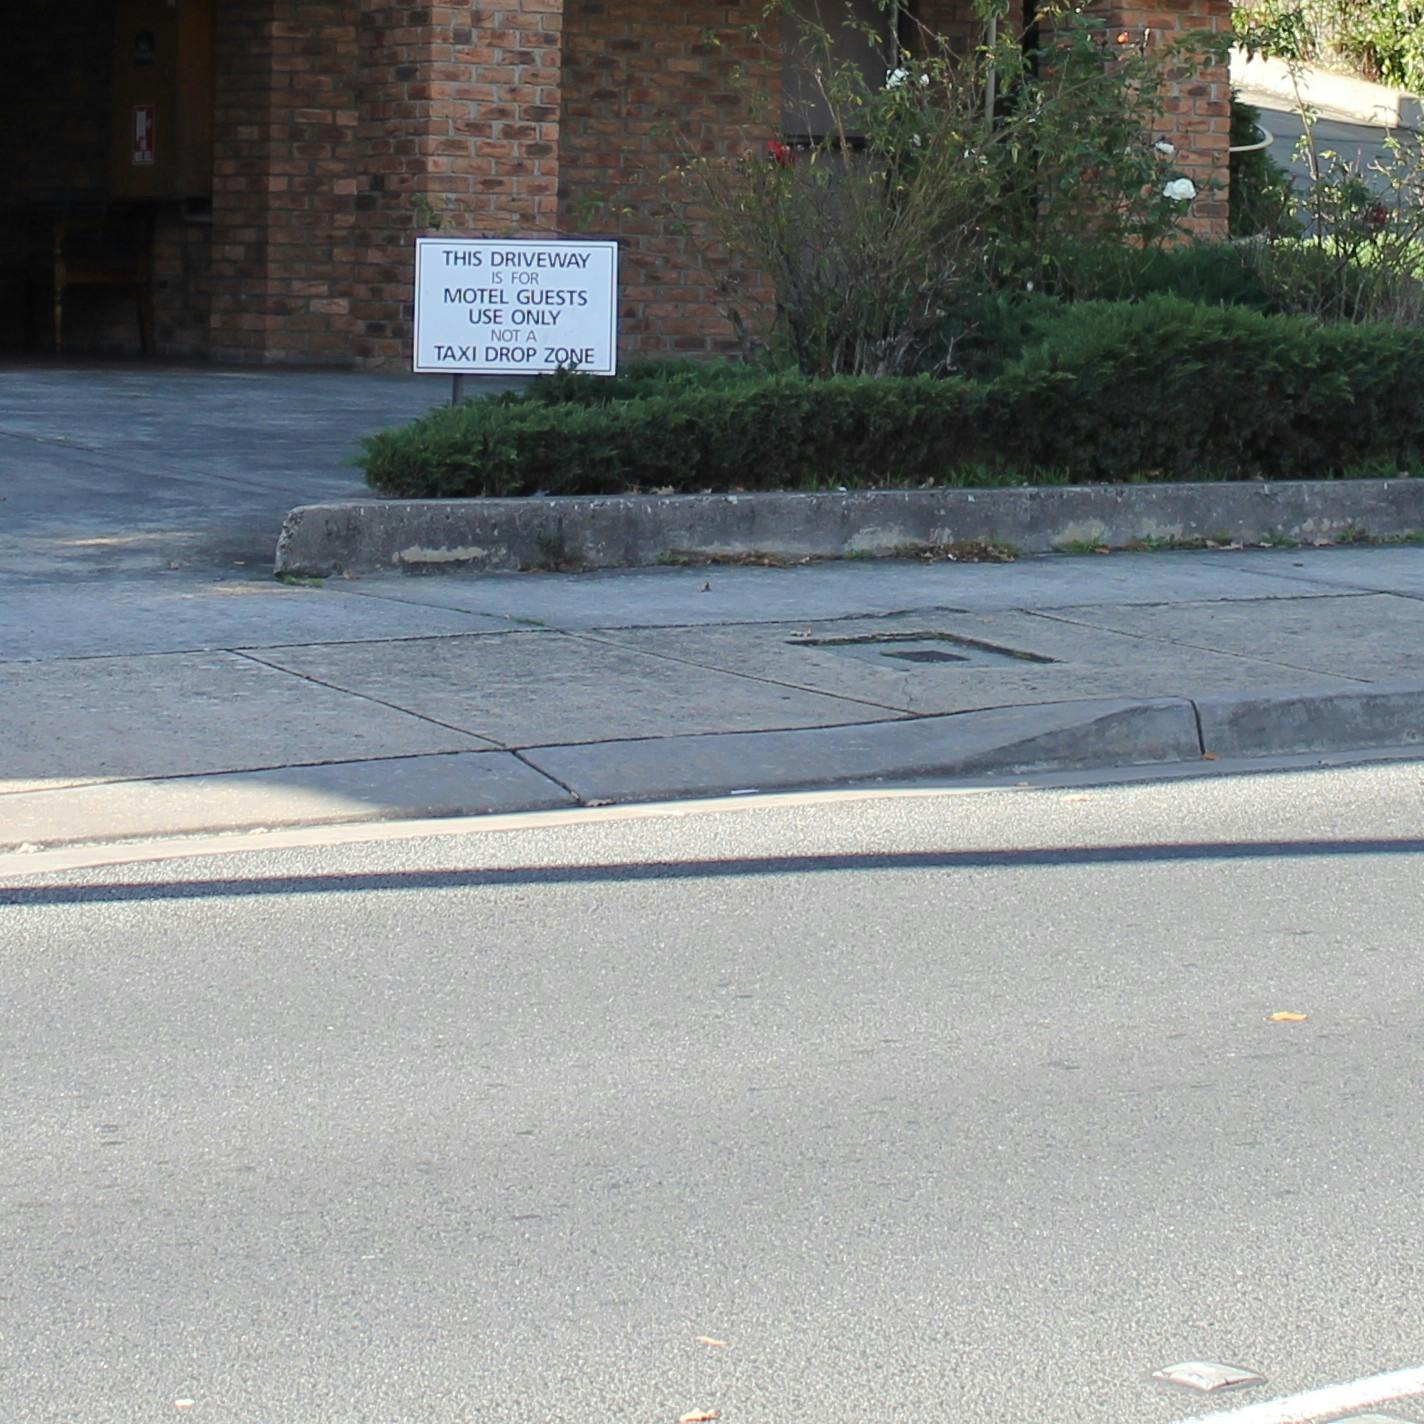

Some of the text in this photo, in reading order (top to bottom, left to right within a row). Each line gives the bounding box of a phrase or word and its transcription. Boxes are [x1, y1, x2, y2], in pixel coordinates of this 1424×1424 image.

[442, 250, 591, 269] THIS DRIVEWAY
[491, 271, 539, 285] IS FOR
[443, 288, 588, 306] MOTEL GUESTS
[468, 308, 561, 325] USE ONLY
[491, 329, 537, 343] NOT A
[434, 345, 595, 364] TAXI DROP ZONE
